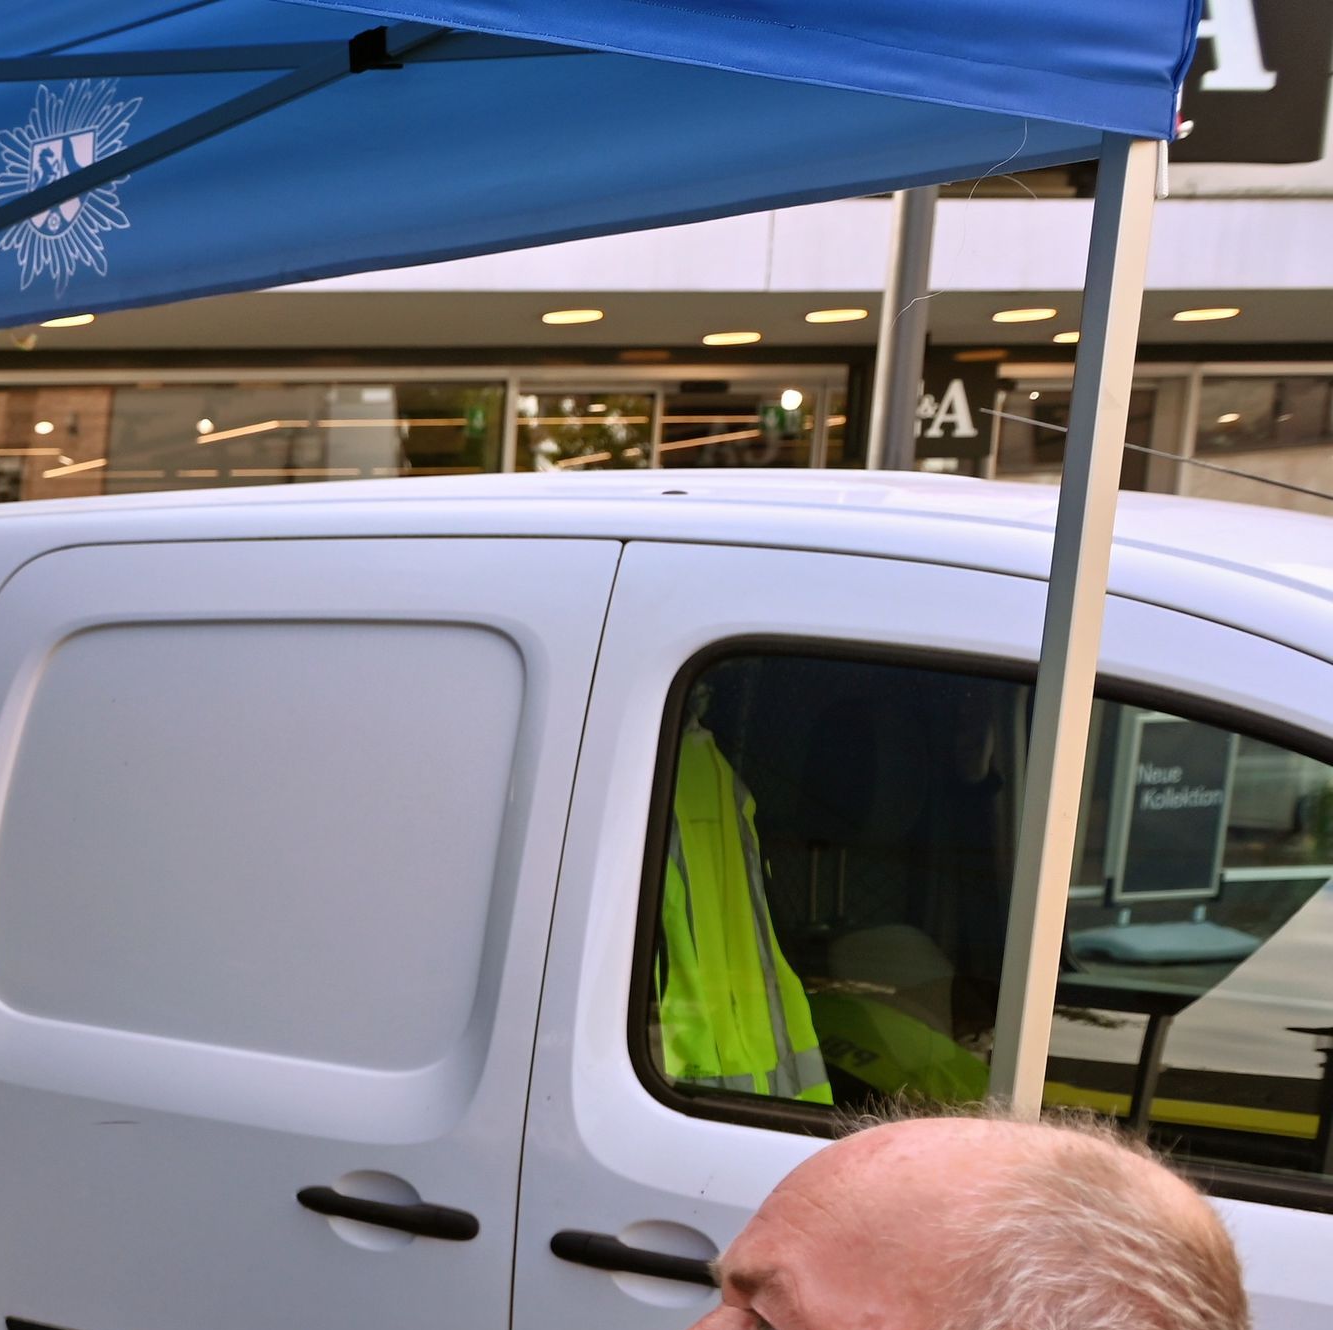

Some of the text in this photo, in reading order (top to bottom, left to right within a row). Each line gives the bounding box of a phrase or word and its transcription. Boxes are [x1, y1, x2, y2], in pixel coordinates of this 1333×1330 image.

[914, 378, 979, 438] &A
[1136, 762, 1183, 785] Neue
[1140, 786, 1226, 811] Kollektion
